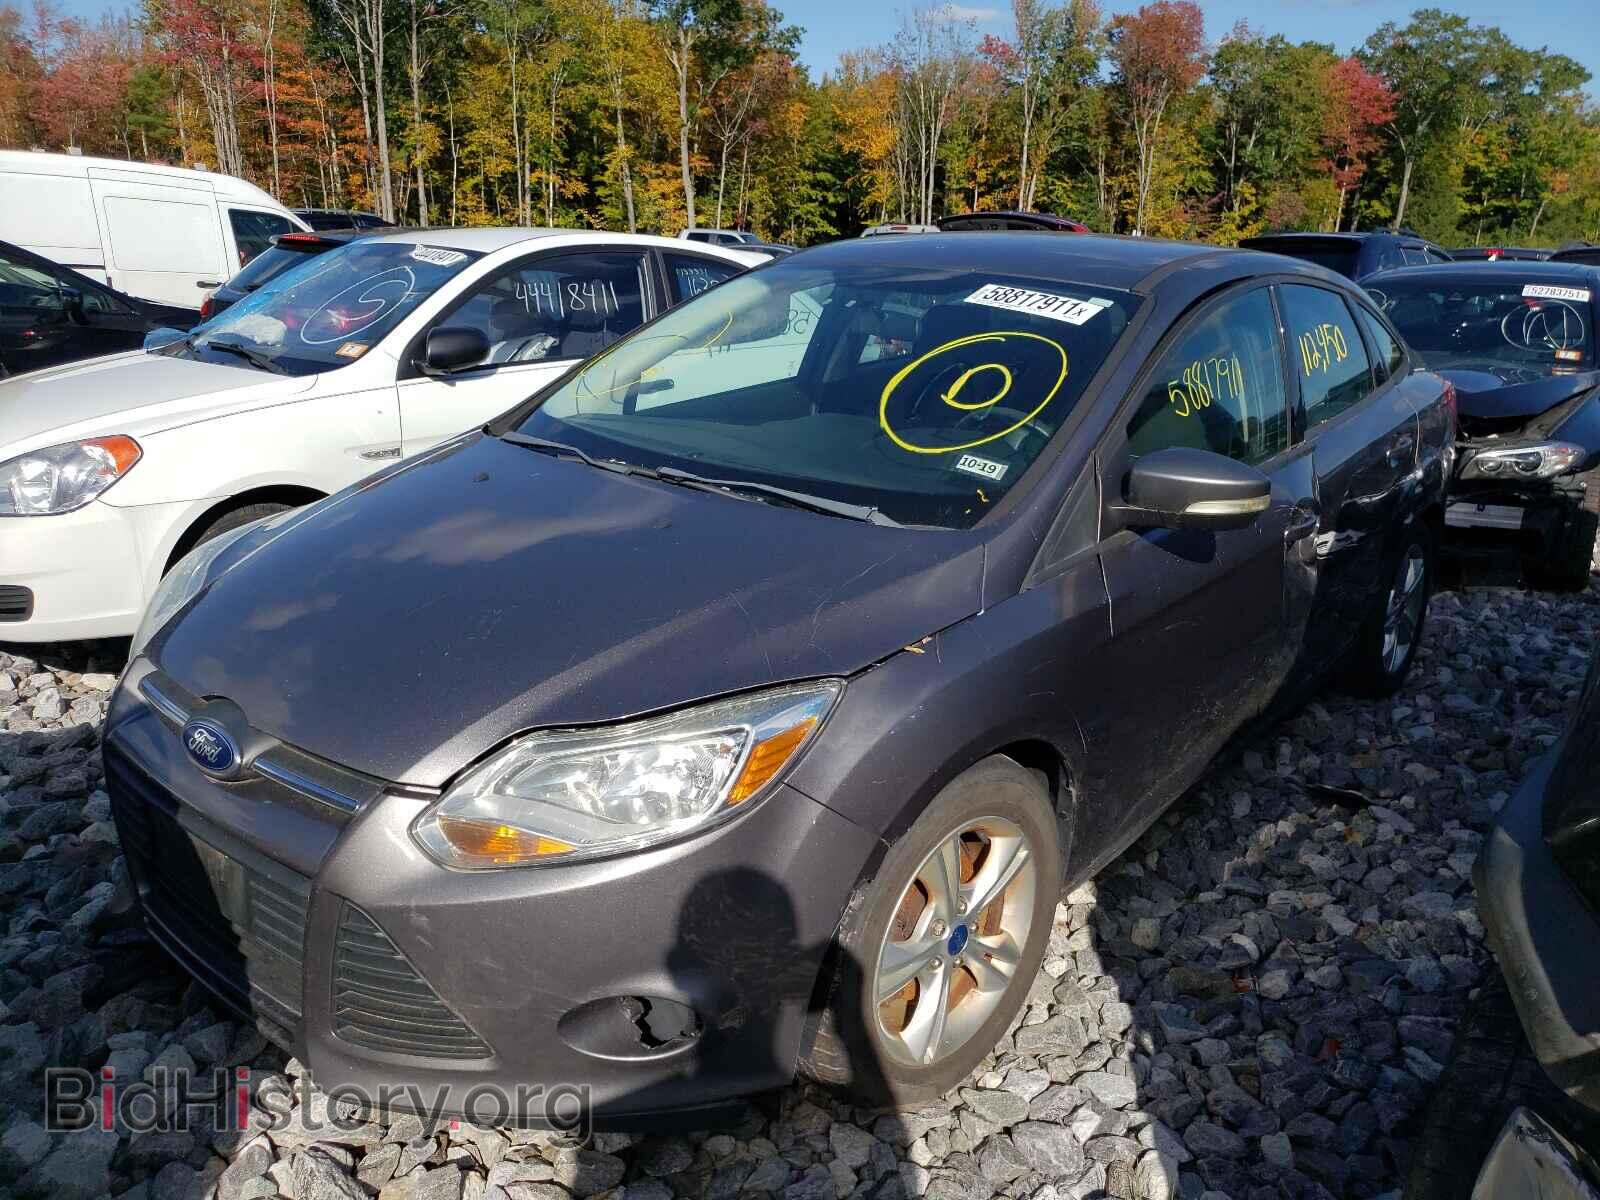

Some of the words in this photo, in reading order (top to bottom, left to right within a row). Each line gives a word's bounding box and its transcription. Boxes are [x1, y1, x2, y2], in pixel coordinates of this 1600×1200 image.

[514, 281, 620, 319] 44418411
[960, 457, 997, 474] 10-19
[188, 728, 223, 764] Ford
